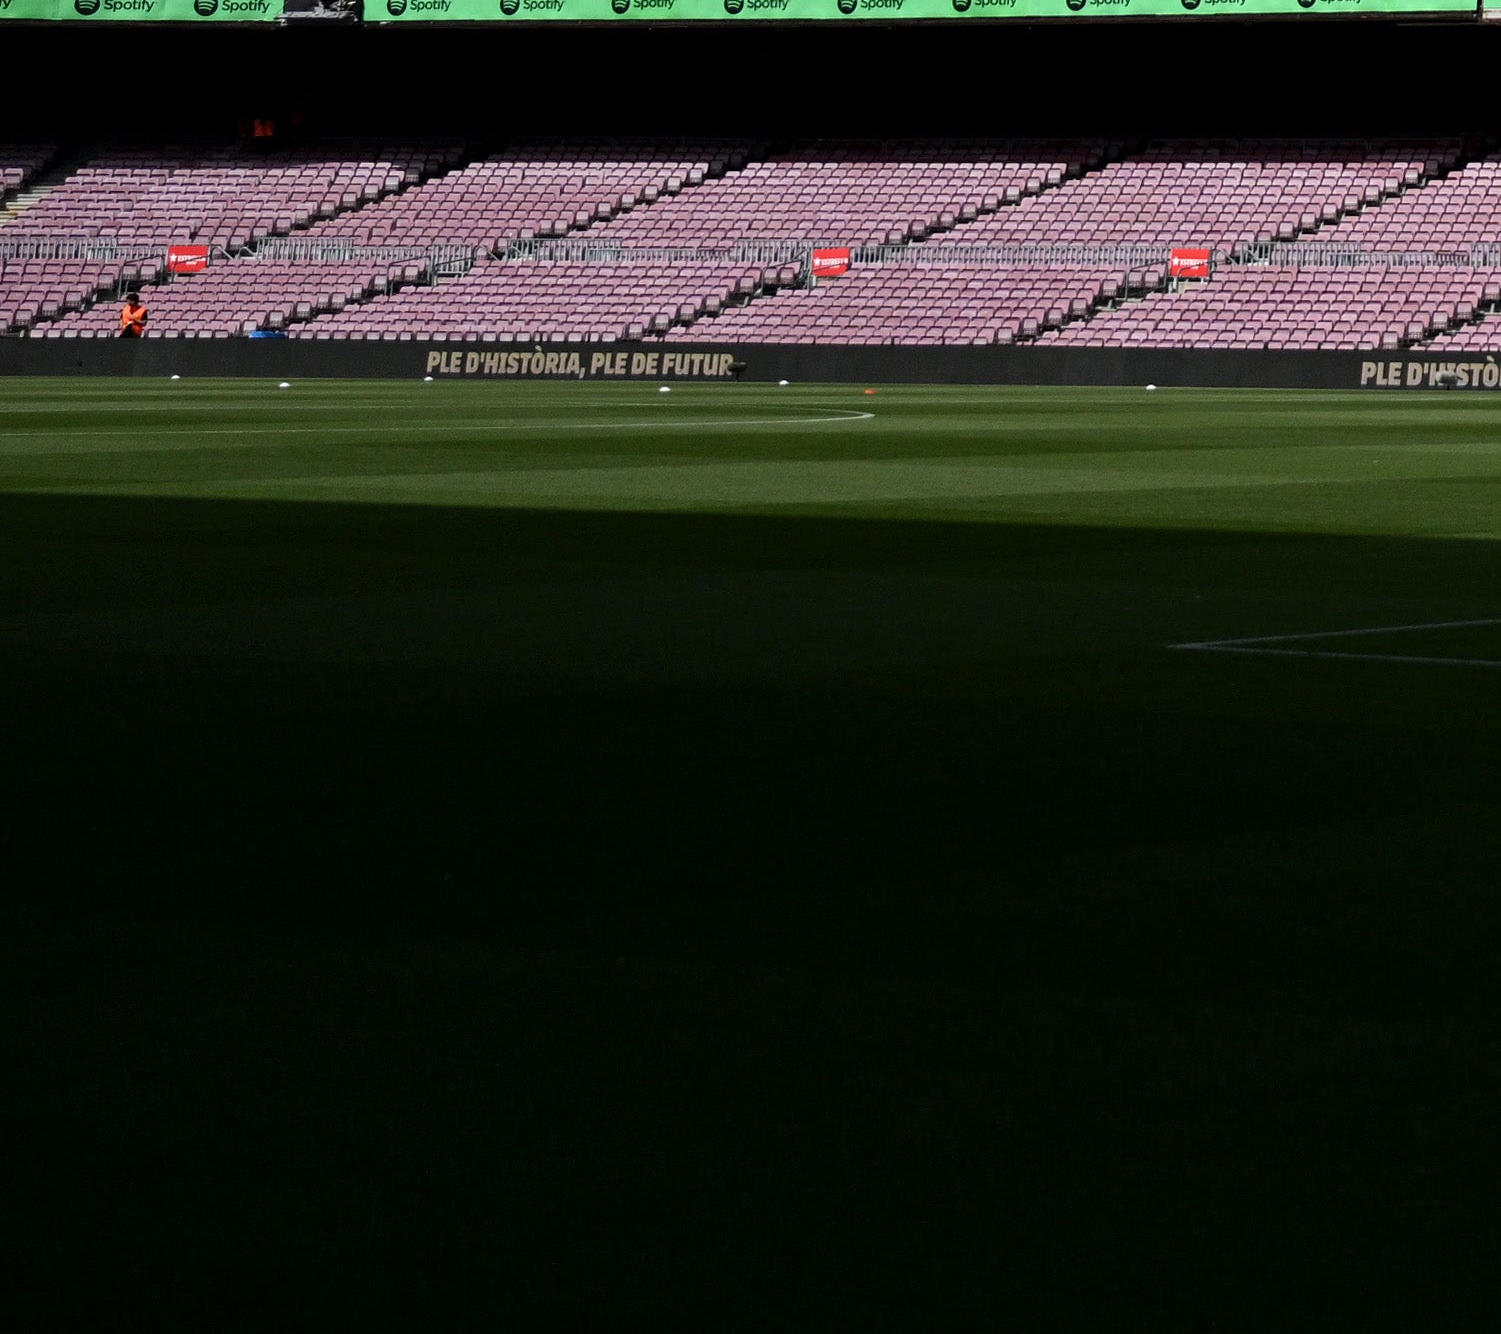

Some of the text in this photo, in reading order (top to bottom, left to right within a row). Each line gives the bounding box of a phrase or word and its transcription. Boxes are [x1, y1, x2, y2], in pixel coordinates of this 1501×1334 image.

[222, 0, 270, 13] Spotify
[427, 345, 734, 378] PLE D'HISTÒRIA, PLE DE FUTUR
[1360, 362, 1402, 385] PLE
